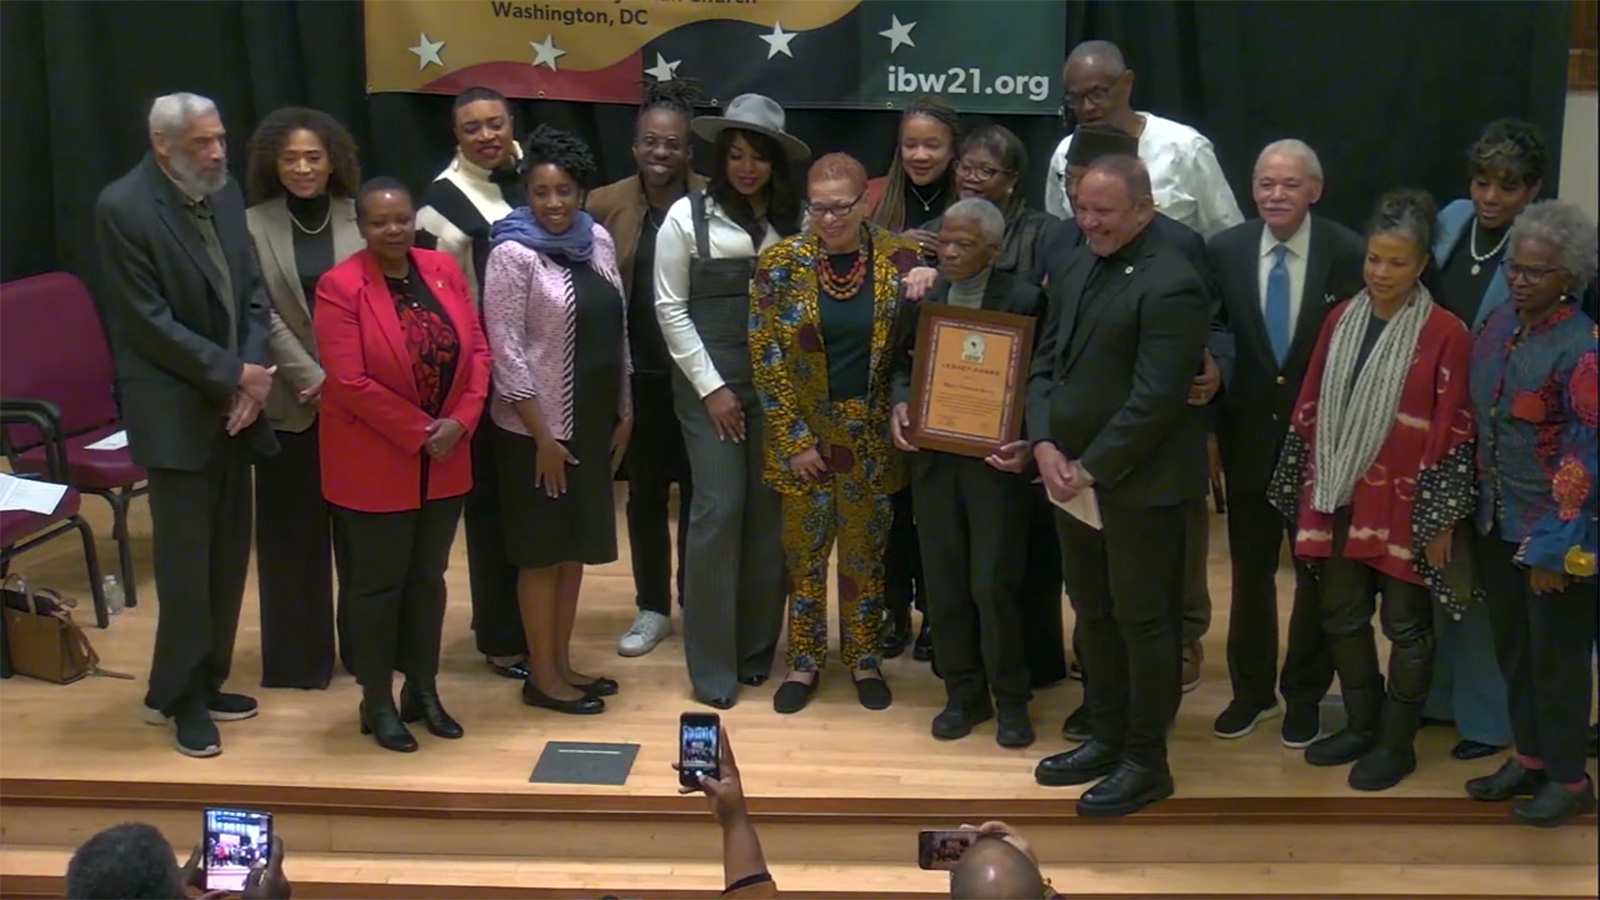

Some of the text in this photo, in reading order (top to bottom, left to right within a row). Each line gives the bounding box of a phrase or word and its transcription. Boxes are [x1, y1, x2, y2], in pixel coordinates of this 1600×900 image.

[491, 1, 648, 26] Washington, DC
[888, 65, 1049, 101] ibw21.org
